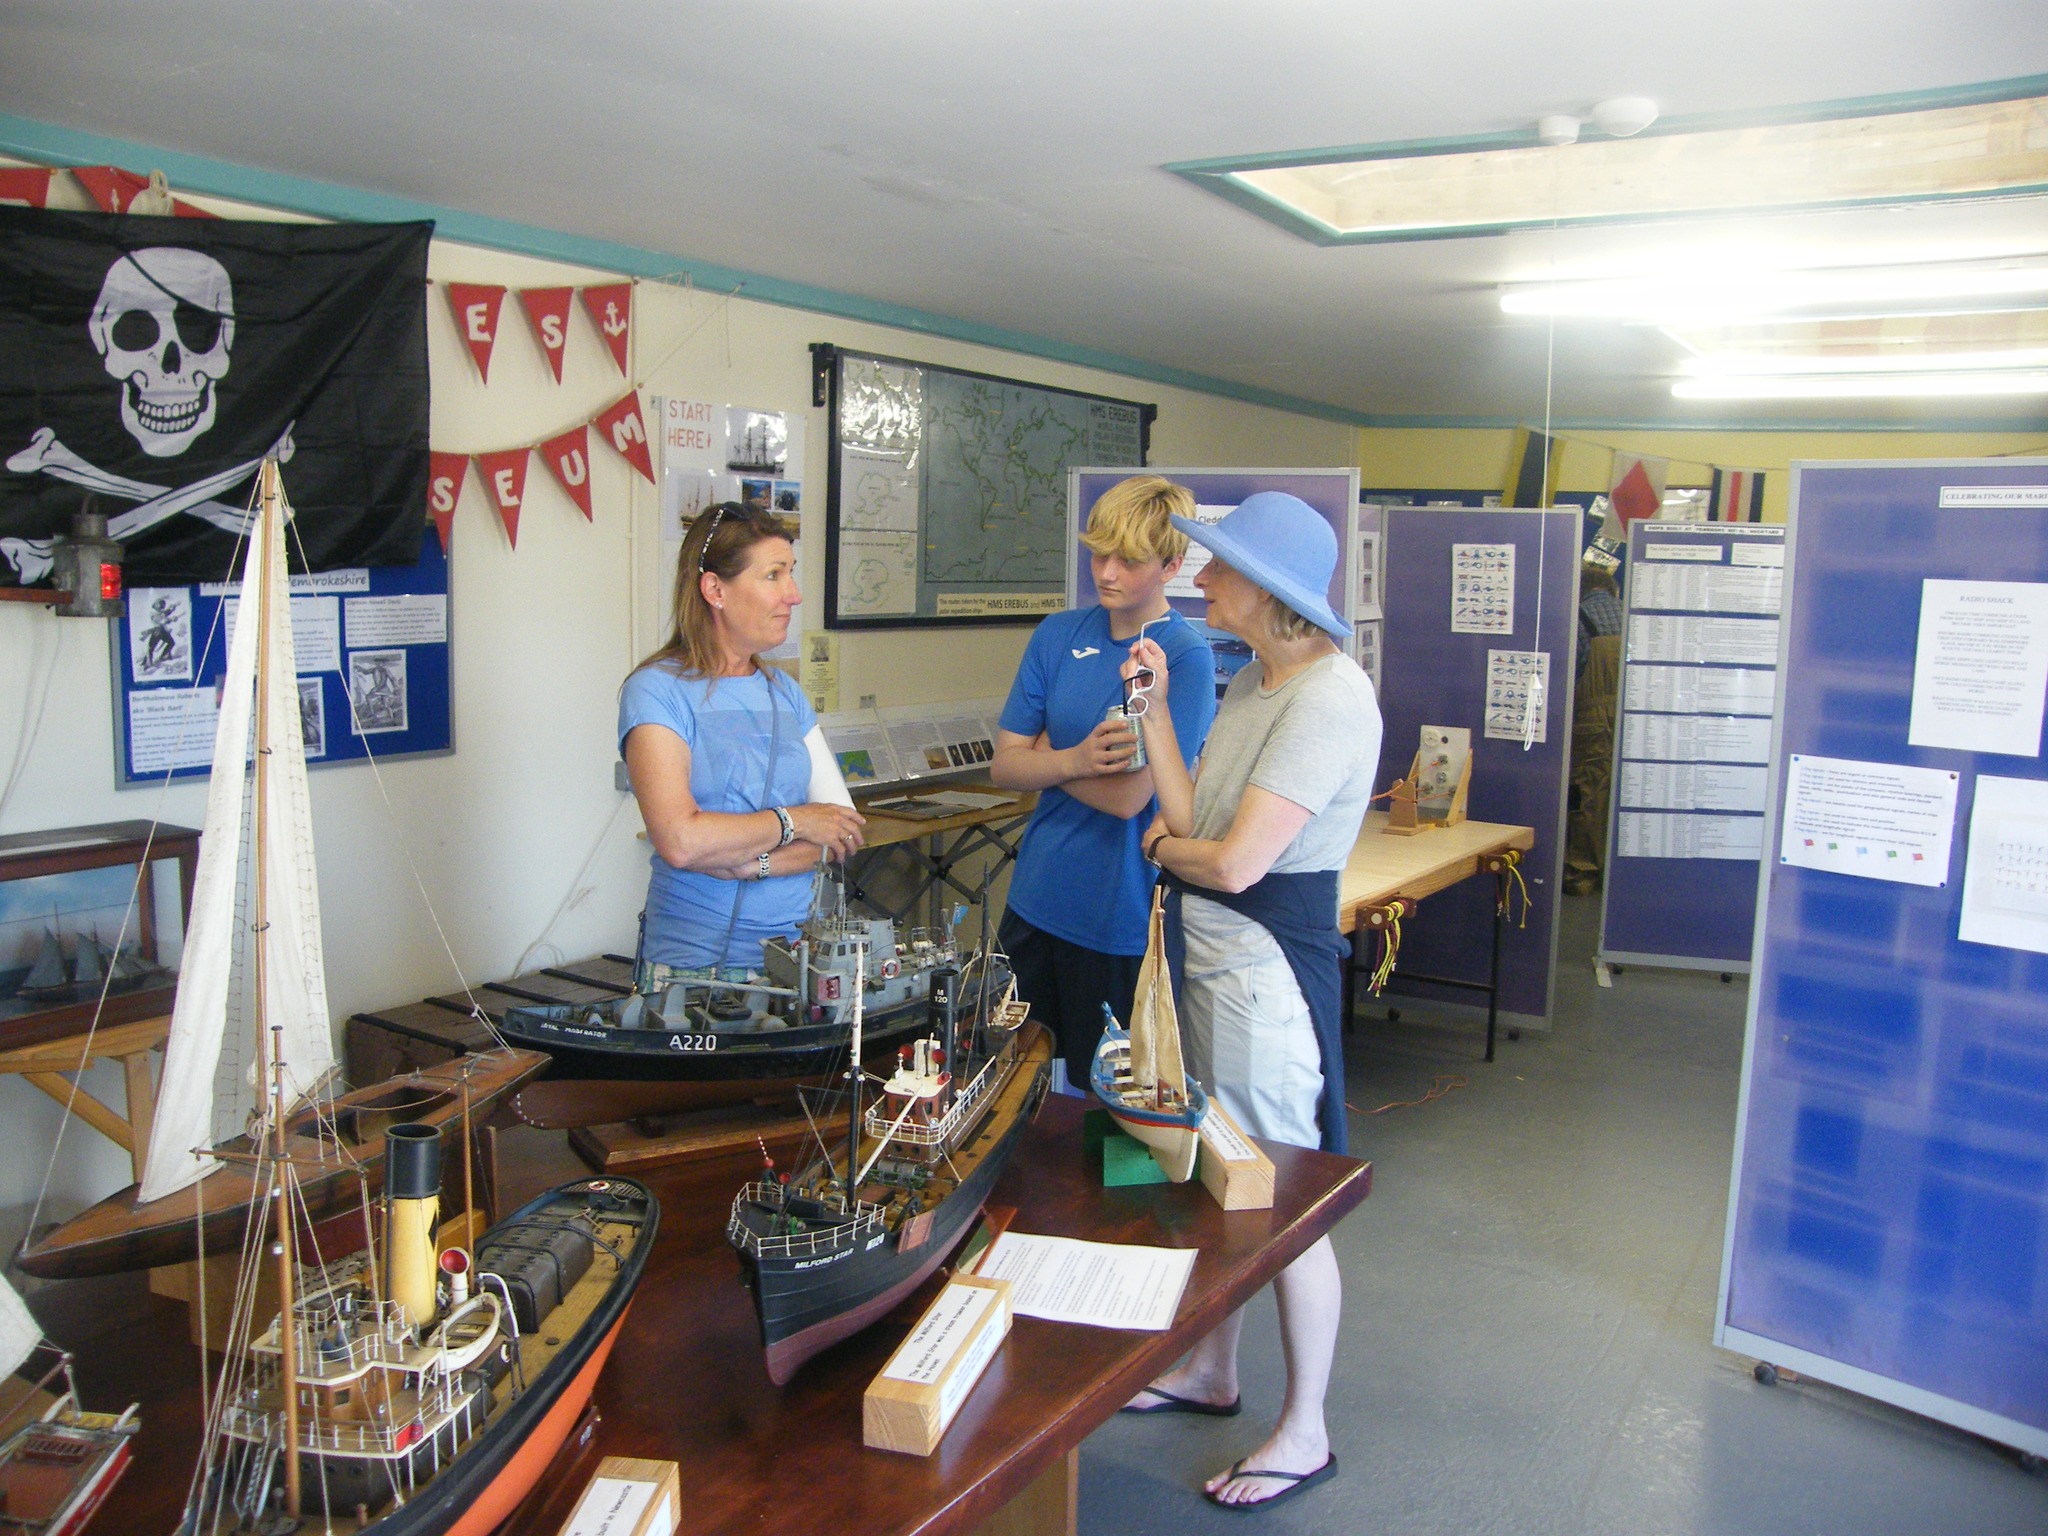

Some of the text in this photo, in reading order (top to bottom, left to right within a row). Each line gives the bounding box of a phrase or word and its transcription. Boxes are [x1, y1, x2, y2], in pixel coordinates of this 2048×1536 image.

[669, 400, 713, 423] START
[290, 574, 367, 588] embrokeshire
[988, 599, 1003, 609] HMS
[1004, 599, 1029, 609] EREBUS
[1041, 599, 1057, 608] HMS
[1959, 595, 2014, 605] RADIO SHACK
[934, 995, 948, 1004] 120
[564, 1027, 607, 1039] MODERATOR
[669, 1034, 717, 1051] A220
[794, 1247, 854, 1269] MILFORD STAR
[908, 1368, 919, 1377] The
[916, 1353, 932, 1369] Milford
[927, 1343, 938, 1354] Star
[609, 1485, 632, 1514] Newcastle
